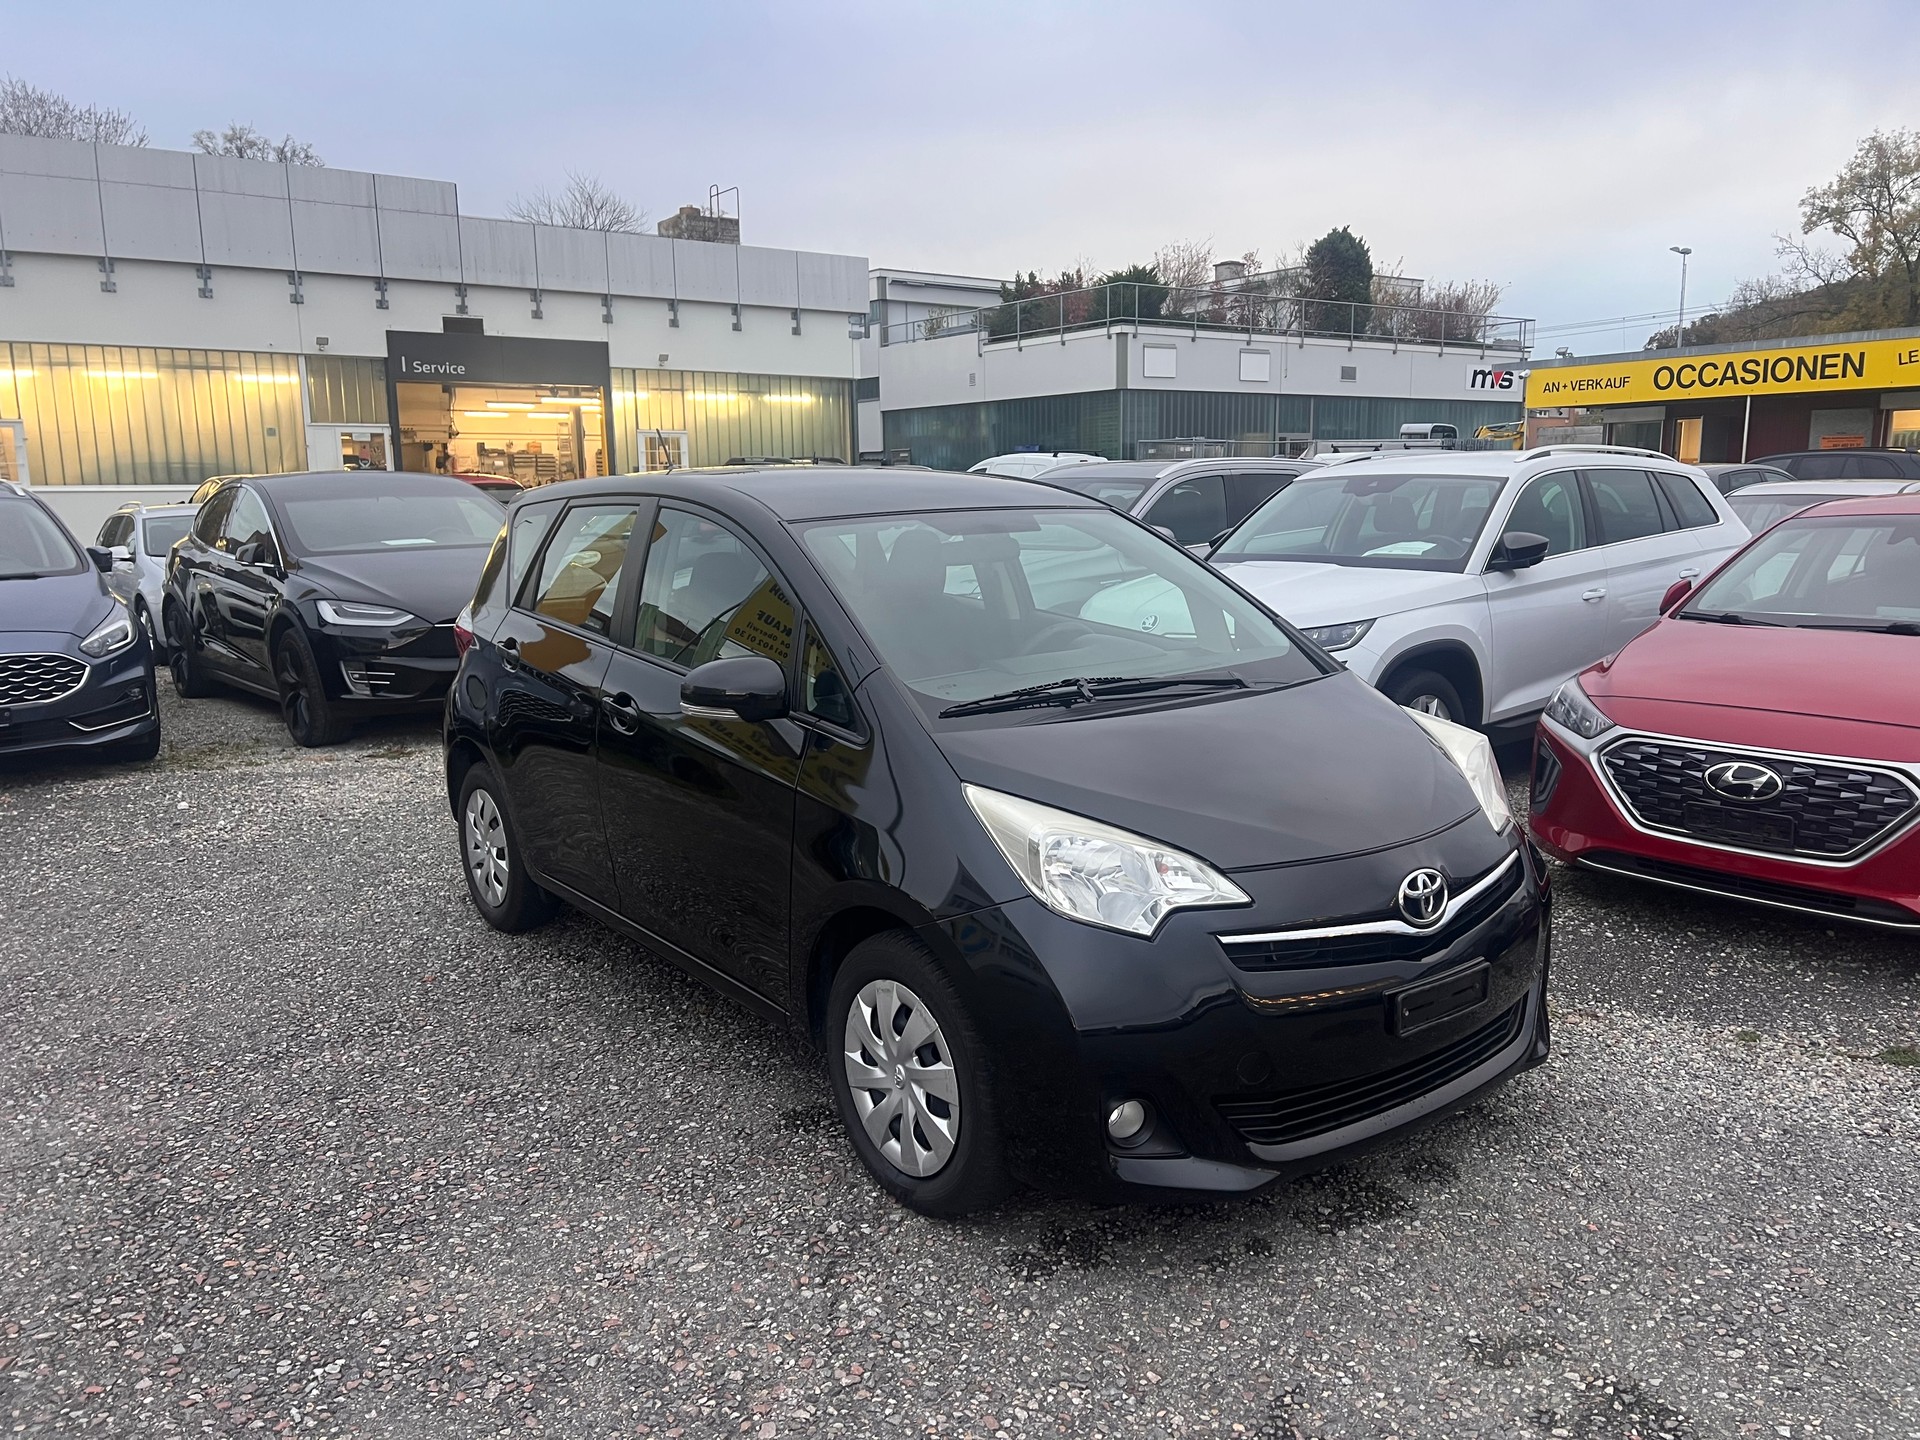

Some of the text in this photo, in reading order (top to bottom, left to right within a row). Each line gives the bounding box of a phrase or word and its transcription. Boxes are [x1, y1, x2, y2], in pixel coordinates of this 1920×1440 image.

[412, 360, 466, 375] Service
[1653, 351, 1866, 391] OCCASIONEN
[1542, 381, 1560, 393] AN
[1569, 376, 1631, 392] VERKAUF
